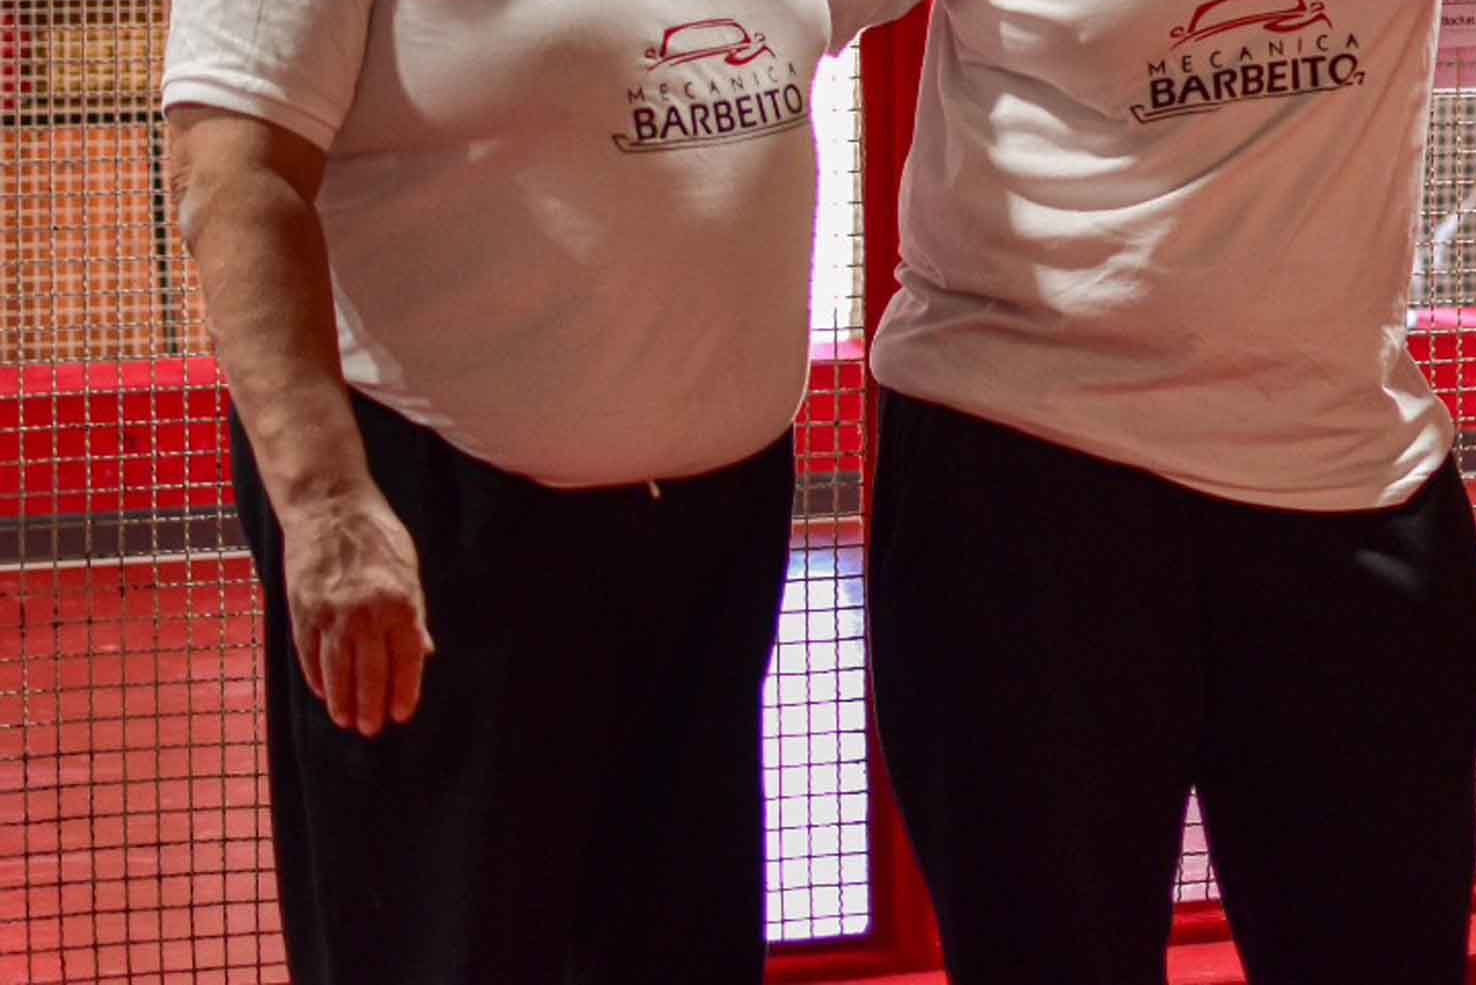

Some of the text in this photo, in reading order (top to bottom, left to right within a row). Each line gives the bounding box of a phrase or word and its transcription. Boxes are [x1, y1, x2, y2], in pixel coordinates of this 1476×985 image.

[1148, 34, 1360, 78] MECANICA
[1149, 52, 1360, 110] BARBEITO
[627, 62, 799, 104] MECANICA
[633, 83, 803, 141] BARBEITO
